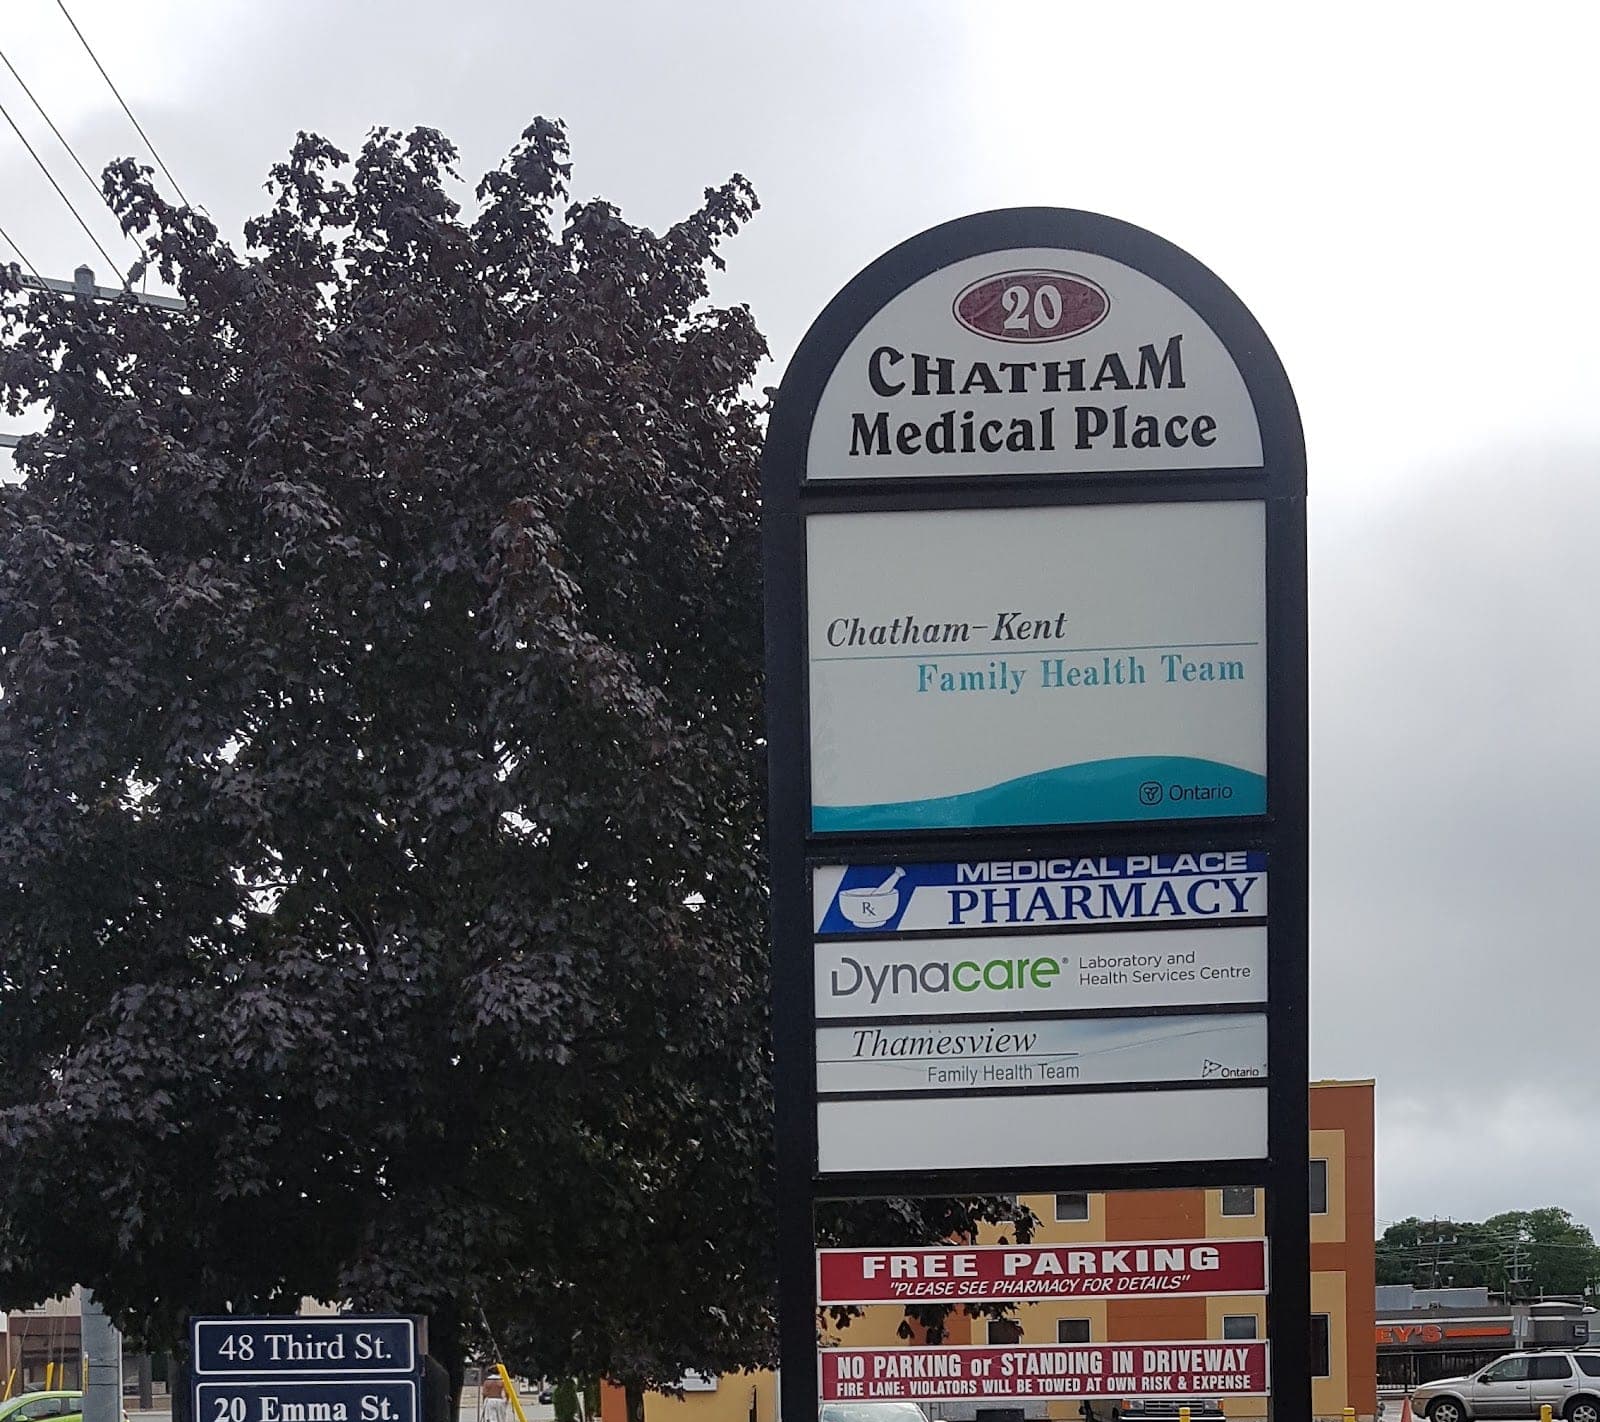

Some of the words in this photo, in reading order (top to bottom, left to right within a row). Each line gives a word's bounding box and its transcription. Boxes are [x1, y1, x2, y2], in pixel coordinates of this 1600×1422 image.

[1001, 285, 1063, 330] 20
[868, 335, 1186, 397] CHATHAM
[849, 407, 1055, 456] Medical
[1074, 406, 1217, 449] Place
[827, 612, 1067, 647] Chatham-Kent
[917, 661, 1027, 694] Family
[1040, 657, 1146, 688] Health
[1161, 654, 1245, 683] Team
[1169, 784, 1232, 801] Ontario
[956, 857, 1120, 883] MEDICAL
[1126, 852, 1247, 875] PLACE
[948, 877, 1257, 924] PHARMACY
[1079, 955, 1161, 969] Laboratory
[1167, 951, 1195, 965] and
[1079, 971, 1127, 985] Health
[1133, 969, 1195, 983] Services
[1200, 967, 1250, 979] Centre
[853, 1028, 1037, 1057] Thamesview
[929, 1066, 978, 1085] Family
[984, 1064, 1033, 1081] Health
[1039, 1063, 1079, 1079] Team
[1221, 1068, 1259, 1077] Ontario
[863, 1254, 978, 1279] FREE
[1004, 1247, 1220, 1276] PARKING
[958, 1281, 988, 1294] SEE
[992, 1278, 1079, 1294] PHARMACY
[1082, 1278, 1112, 1291] FOR
[218, 1335, 254, 1361] 48
[264, 1334, 345, 1360] Third
[355, 1333, 392, 1359] St.
[837, 1356, 865, 1379] NO
[874, 1354, 962, 1378] PARKING
[971, 1358, 992, 1376] or
[1001, 1351, 1102, 1376] STANDING
[1113, 1351, 1134, 1373] IN
[1143, 1348, 1249, 1372] DRIVEWAY
[837, 1382, 863, 1396] FIRE
[869, 1381, 904, 1396] LANE:
[910, 1380, 976, 1395] VIOLATORS
[982, 1379, 1012, 1393] WILL
[1017, 1379, 1032, 1392] BE
[1038, 1378, 1080, 1393] TOWED
[1086, 1377, 1102, 1391] AT
[1107, 1377, 1141, 1391] OWN
[1142, 1376, 1171, 1390] RISK
[1178, 1376, 1187, 1389] &
[1193, 1375, 1250, 1389] EXPENSE
[214, 1397, 247, 1422] 20
[259, 1396, 348, 1422] Emma
[360, 1395, 399, 1421] St.
